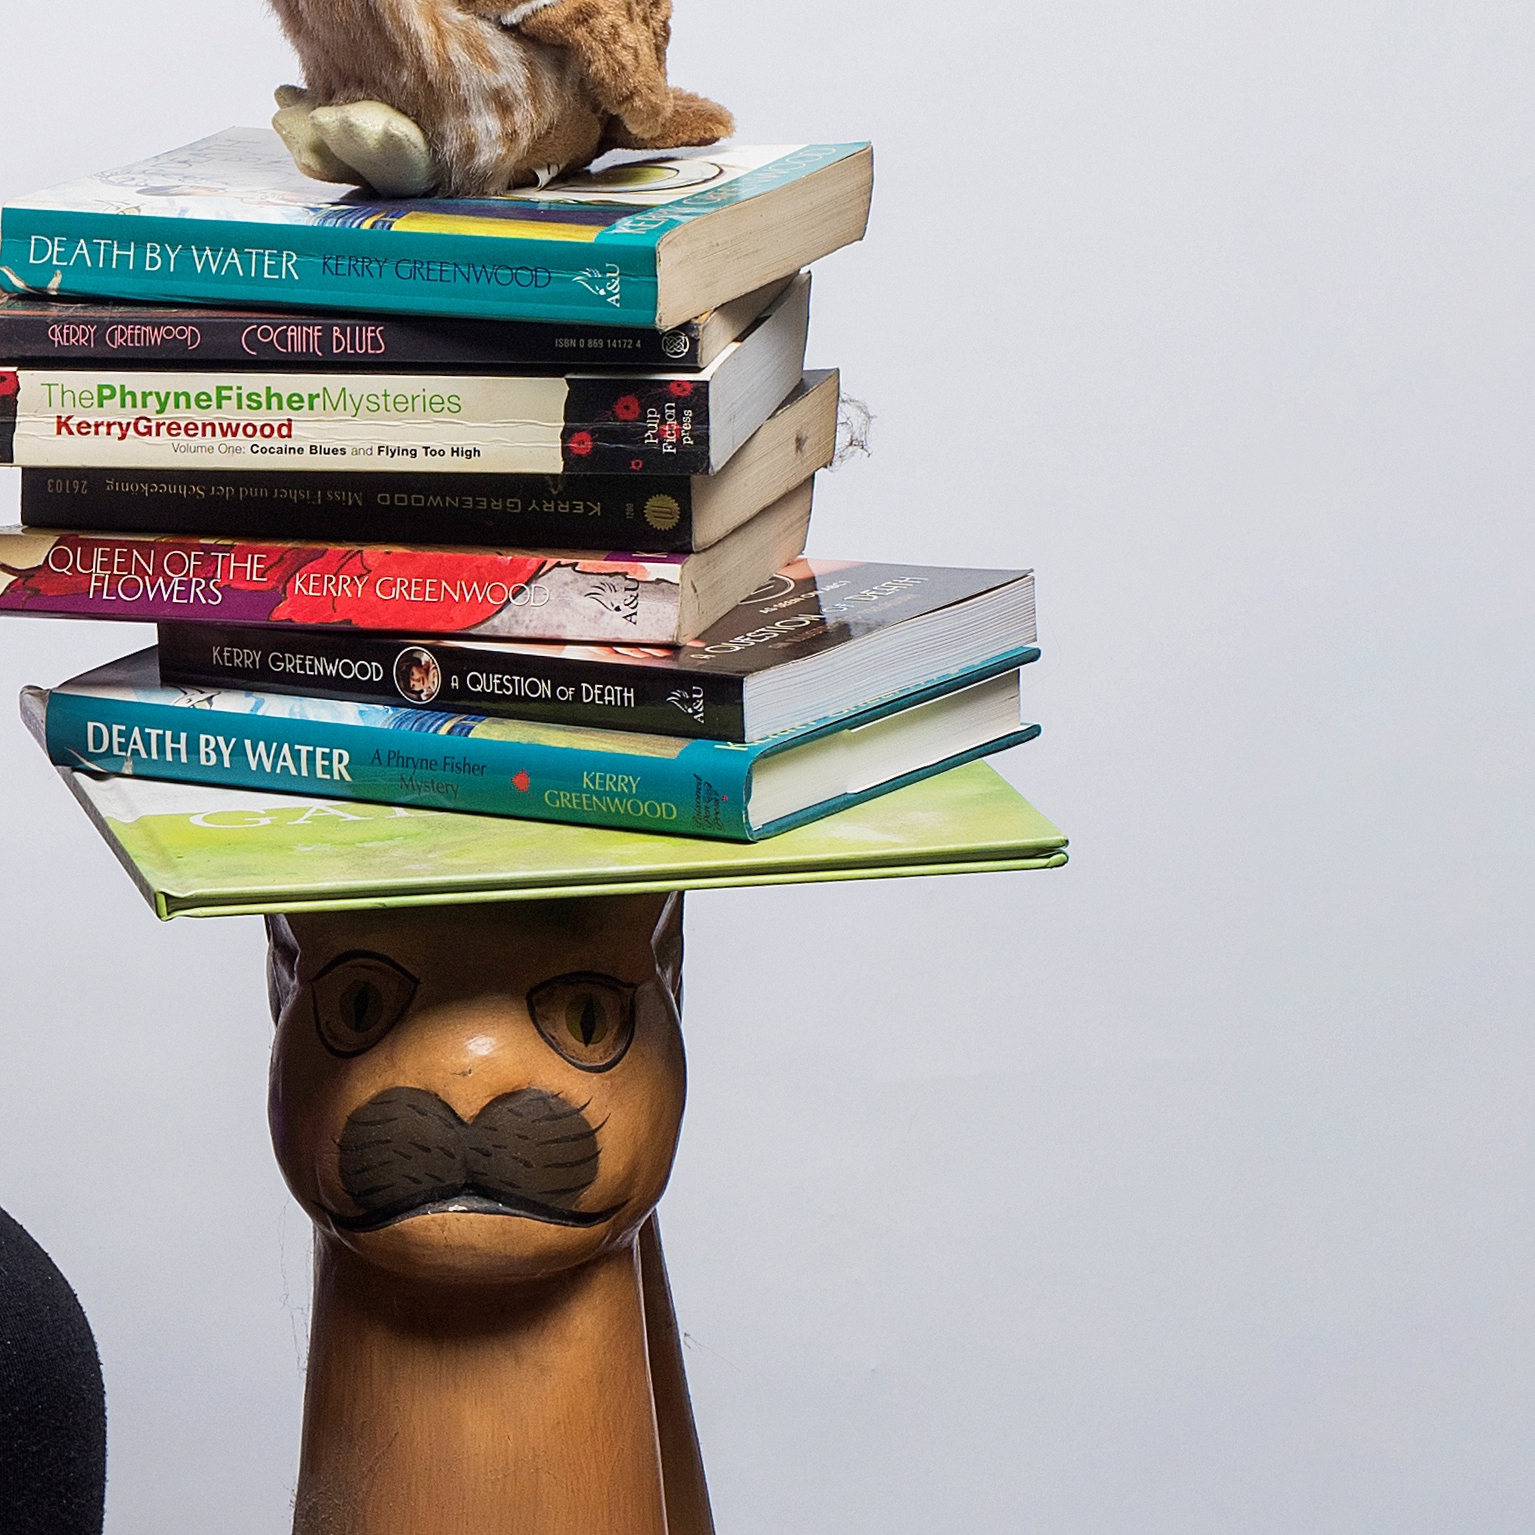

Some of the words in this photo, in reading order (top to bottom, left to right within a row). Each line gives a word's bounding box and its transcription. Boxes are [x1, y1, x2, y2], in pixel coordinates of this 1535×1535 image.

[29, 235, 134, 270] DEATH
[145, 242, 182, 272] BY
[191, 245, 299, 280] WATER
[322, 253, 390, 279] KERRY
[394, 258, 552, 288] GREENWOOD
[605, 263, 621, 308] A&U
[48, 324, 96, 348] KERRY
[105, 324, 201, 350] GREENWOOD
[241, 324, 323, 356] COCAINE
[332, 326, 386, 354] BLUES
[555, 338, 576, 348] ISBN
[587, 338, 604, 348] 869
[607, 338, 633, 349] 14172
[636, 339, 642, 348] 4
[644, 408, 661, 445] Pulp
[662, 402, 677, 455] Fiction
[681, 409, 694, 446] press
[171, 442, 215, 455] Volume
[218, 443, 246, 456] One:
[250, 443, 305, 456] Cocaine
[310, 444, 347, 456] Blues
[351, 445, 373, 457] and
[377, 445, 417, 458] Flying
[422, 446, 446, 458] Too
[451, 446, 481, 459] High
[47, 480, 88, 494] 26103
[105, 478, 207, 500] Schneekönig
[210, 483, 235, 500] der
[239, 485, 270, 500] und
[272, 486, 322, 505] Fisher
[326, 489, 364, 506] Miss
[377, 492, 522, 514] GREENWOOD
[527, 499, 602, 517] KERRY
[48, 545, 154, 576] QUEEN
[163, 550, 204, 578] OF
[211, 552, 268, 582] THE
[89, 573, 223, 605] FLOWERS
[294, 573, 369, 598] KERRY
[375, 576, 551, 608] GREENWOOD
[621, 577, 639, 626] A&U
[704, 613, 827, 655] QUESTION
[212, 645, 260, 671] KERRY
[268, 652, 383, 683] GREENWOOD
[450, 675, 459, 690] A
[467, 670, 551, 700] QUESTION
[581, 681, 635, 709] DEATH
[692, 686, 704, 724] A&U
[87, 721, 187, 764] DEATH
[199, 733, 236, 769] BY
[244, 738, 352, 782] WATER
[371, 749, 383, 765] A
[387, 749, 438, 776] Phryne
[443, 755, 487, 777] Fisher
[399, 774, 459, 800] Mystery
[583, 770, 641, 795] KERRY
[544, 790, 677, 821] GREENWOOD
